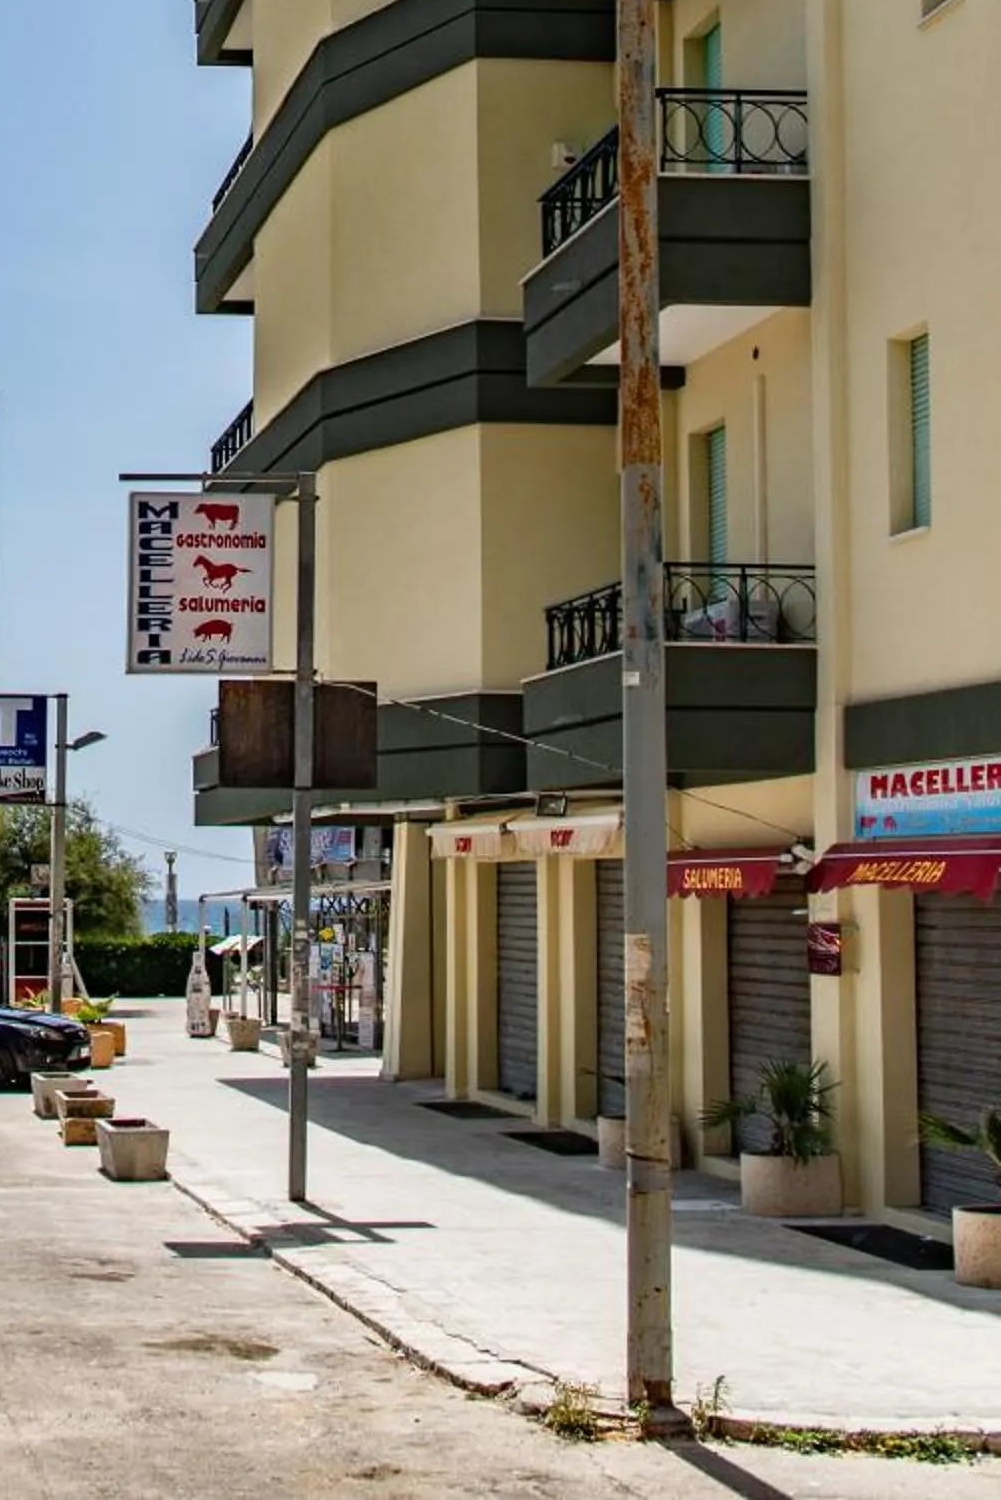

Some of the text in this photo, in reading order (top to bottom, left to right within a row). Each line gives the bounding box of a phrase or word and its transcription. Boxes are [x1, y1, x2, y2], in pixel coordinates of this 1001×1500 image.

[137, 501, 179, 665] MACELLERIA
[13, 768, 44, 793] Shop
[683, 867, 743, 889] SALUMERIA
[848, 861, 948, 883] MACELLERIA
